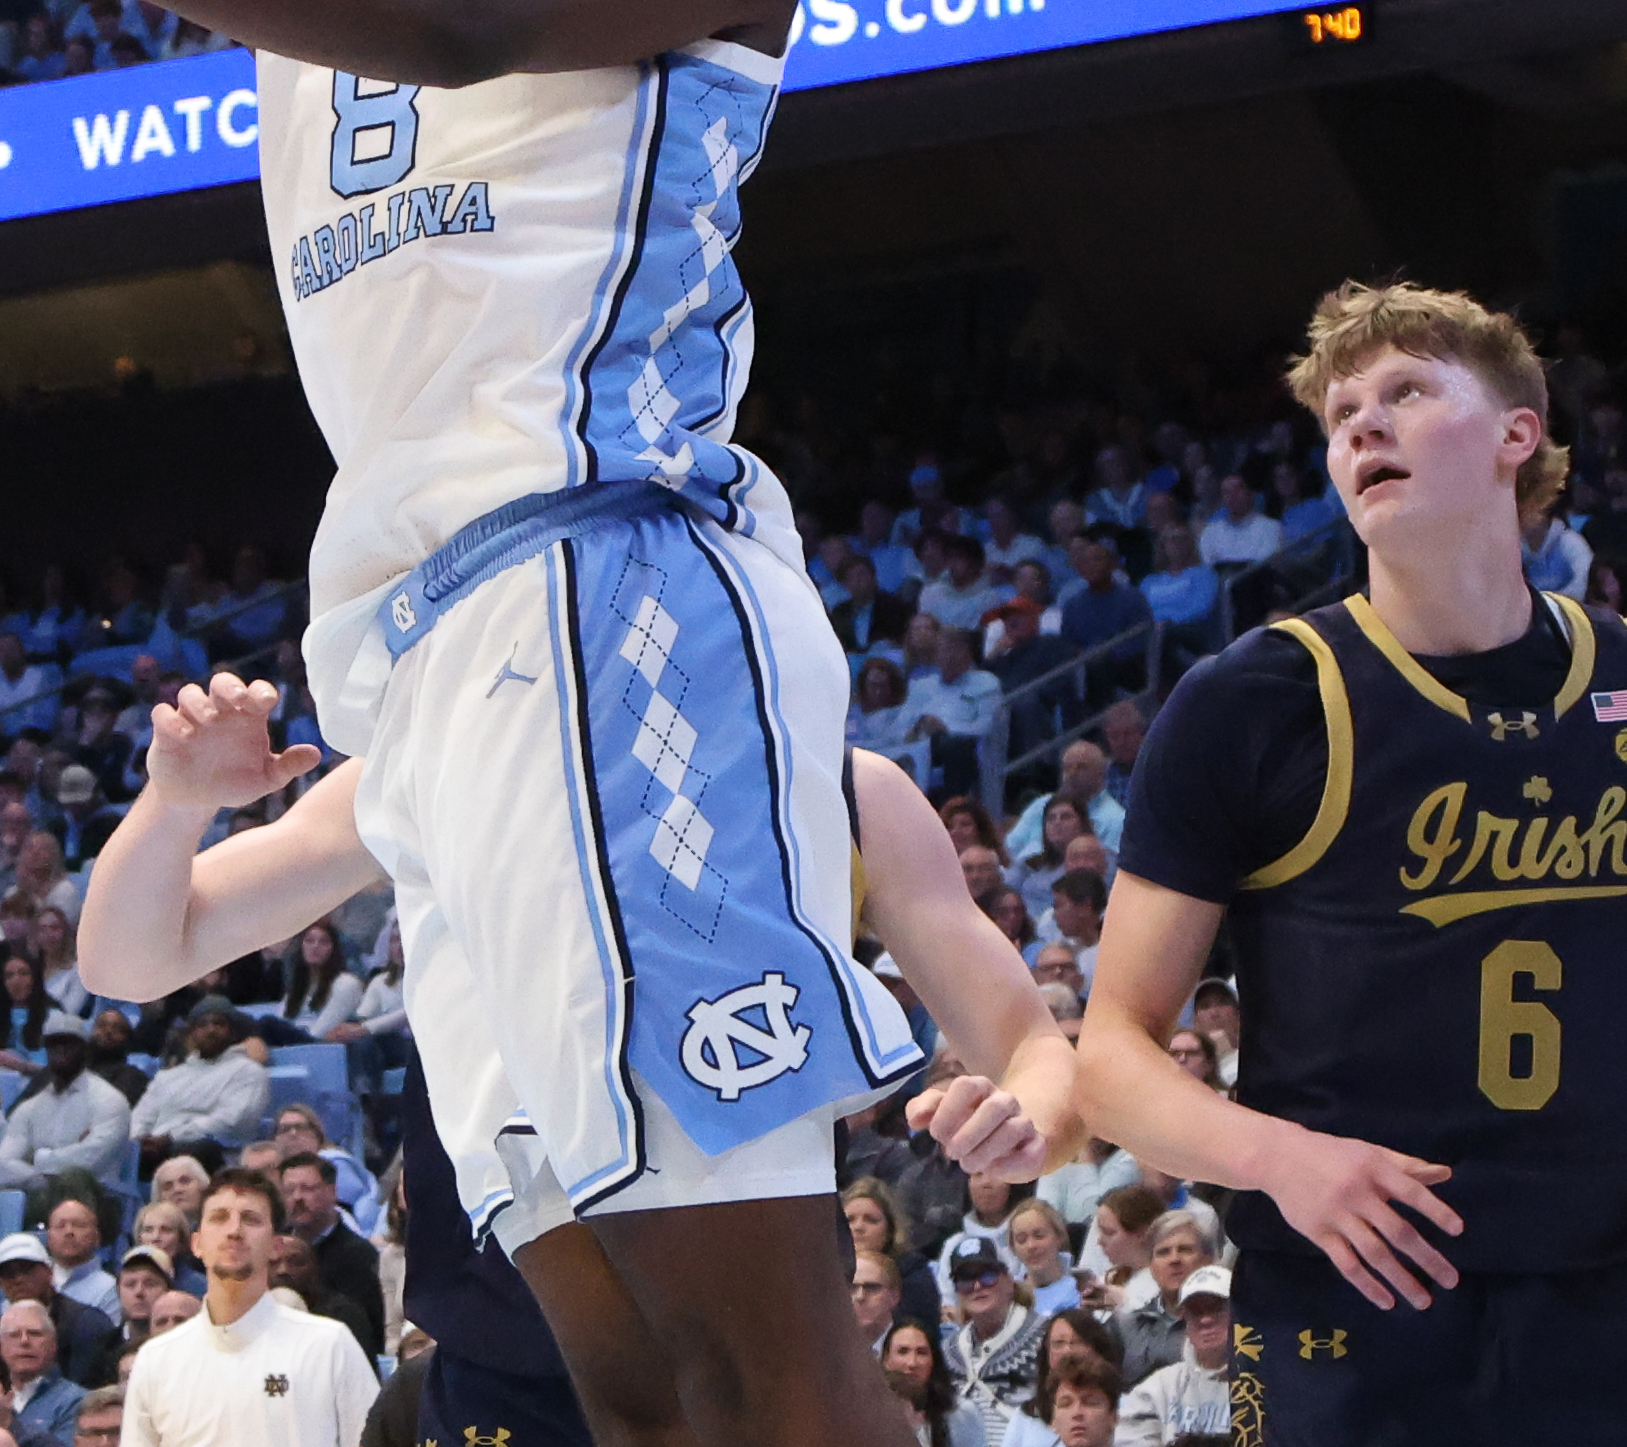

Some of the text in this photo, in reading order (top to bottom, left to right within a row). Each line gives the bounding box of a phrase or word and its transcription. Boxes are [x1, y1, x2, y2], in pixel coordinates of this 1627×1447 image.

[73, 87, 257, 171] WATC
[331, 70, 420, 200] 8
[1477, 939, 1562, 1110] 6
